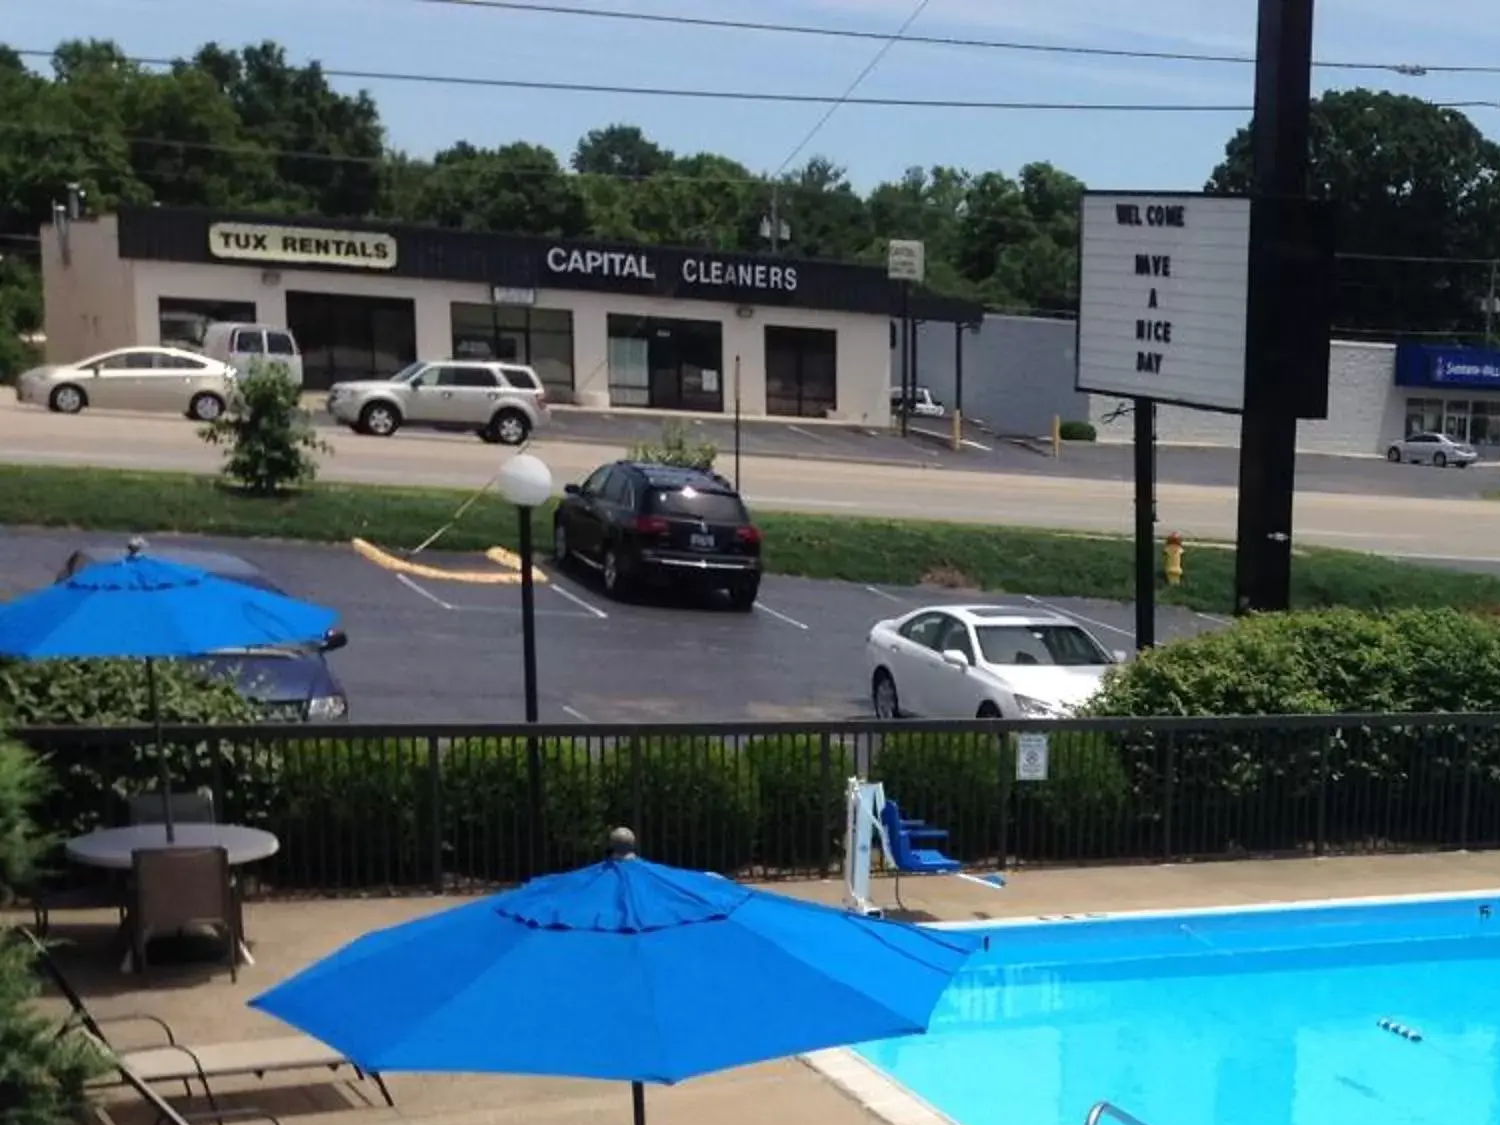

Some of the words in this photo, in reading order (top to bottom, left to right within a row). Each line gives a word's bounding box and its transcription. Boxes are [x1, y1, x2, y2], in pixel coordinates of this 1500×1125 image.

[220, 232, 267, 251] TUX
[282, 235, 388, 259] RENTALS
[547, 247, 656, 279] CAPITAL
[682, 259, 797, 291] CLEANERS
[1135, 254, 1171, 277] HAVE
[1148, 287, 1158, 309] A
[1136, 319, 1172, 343] NICE
[1136, 351, 1163, 375] DAY
